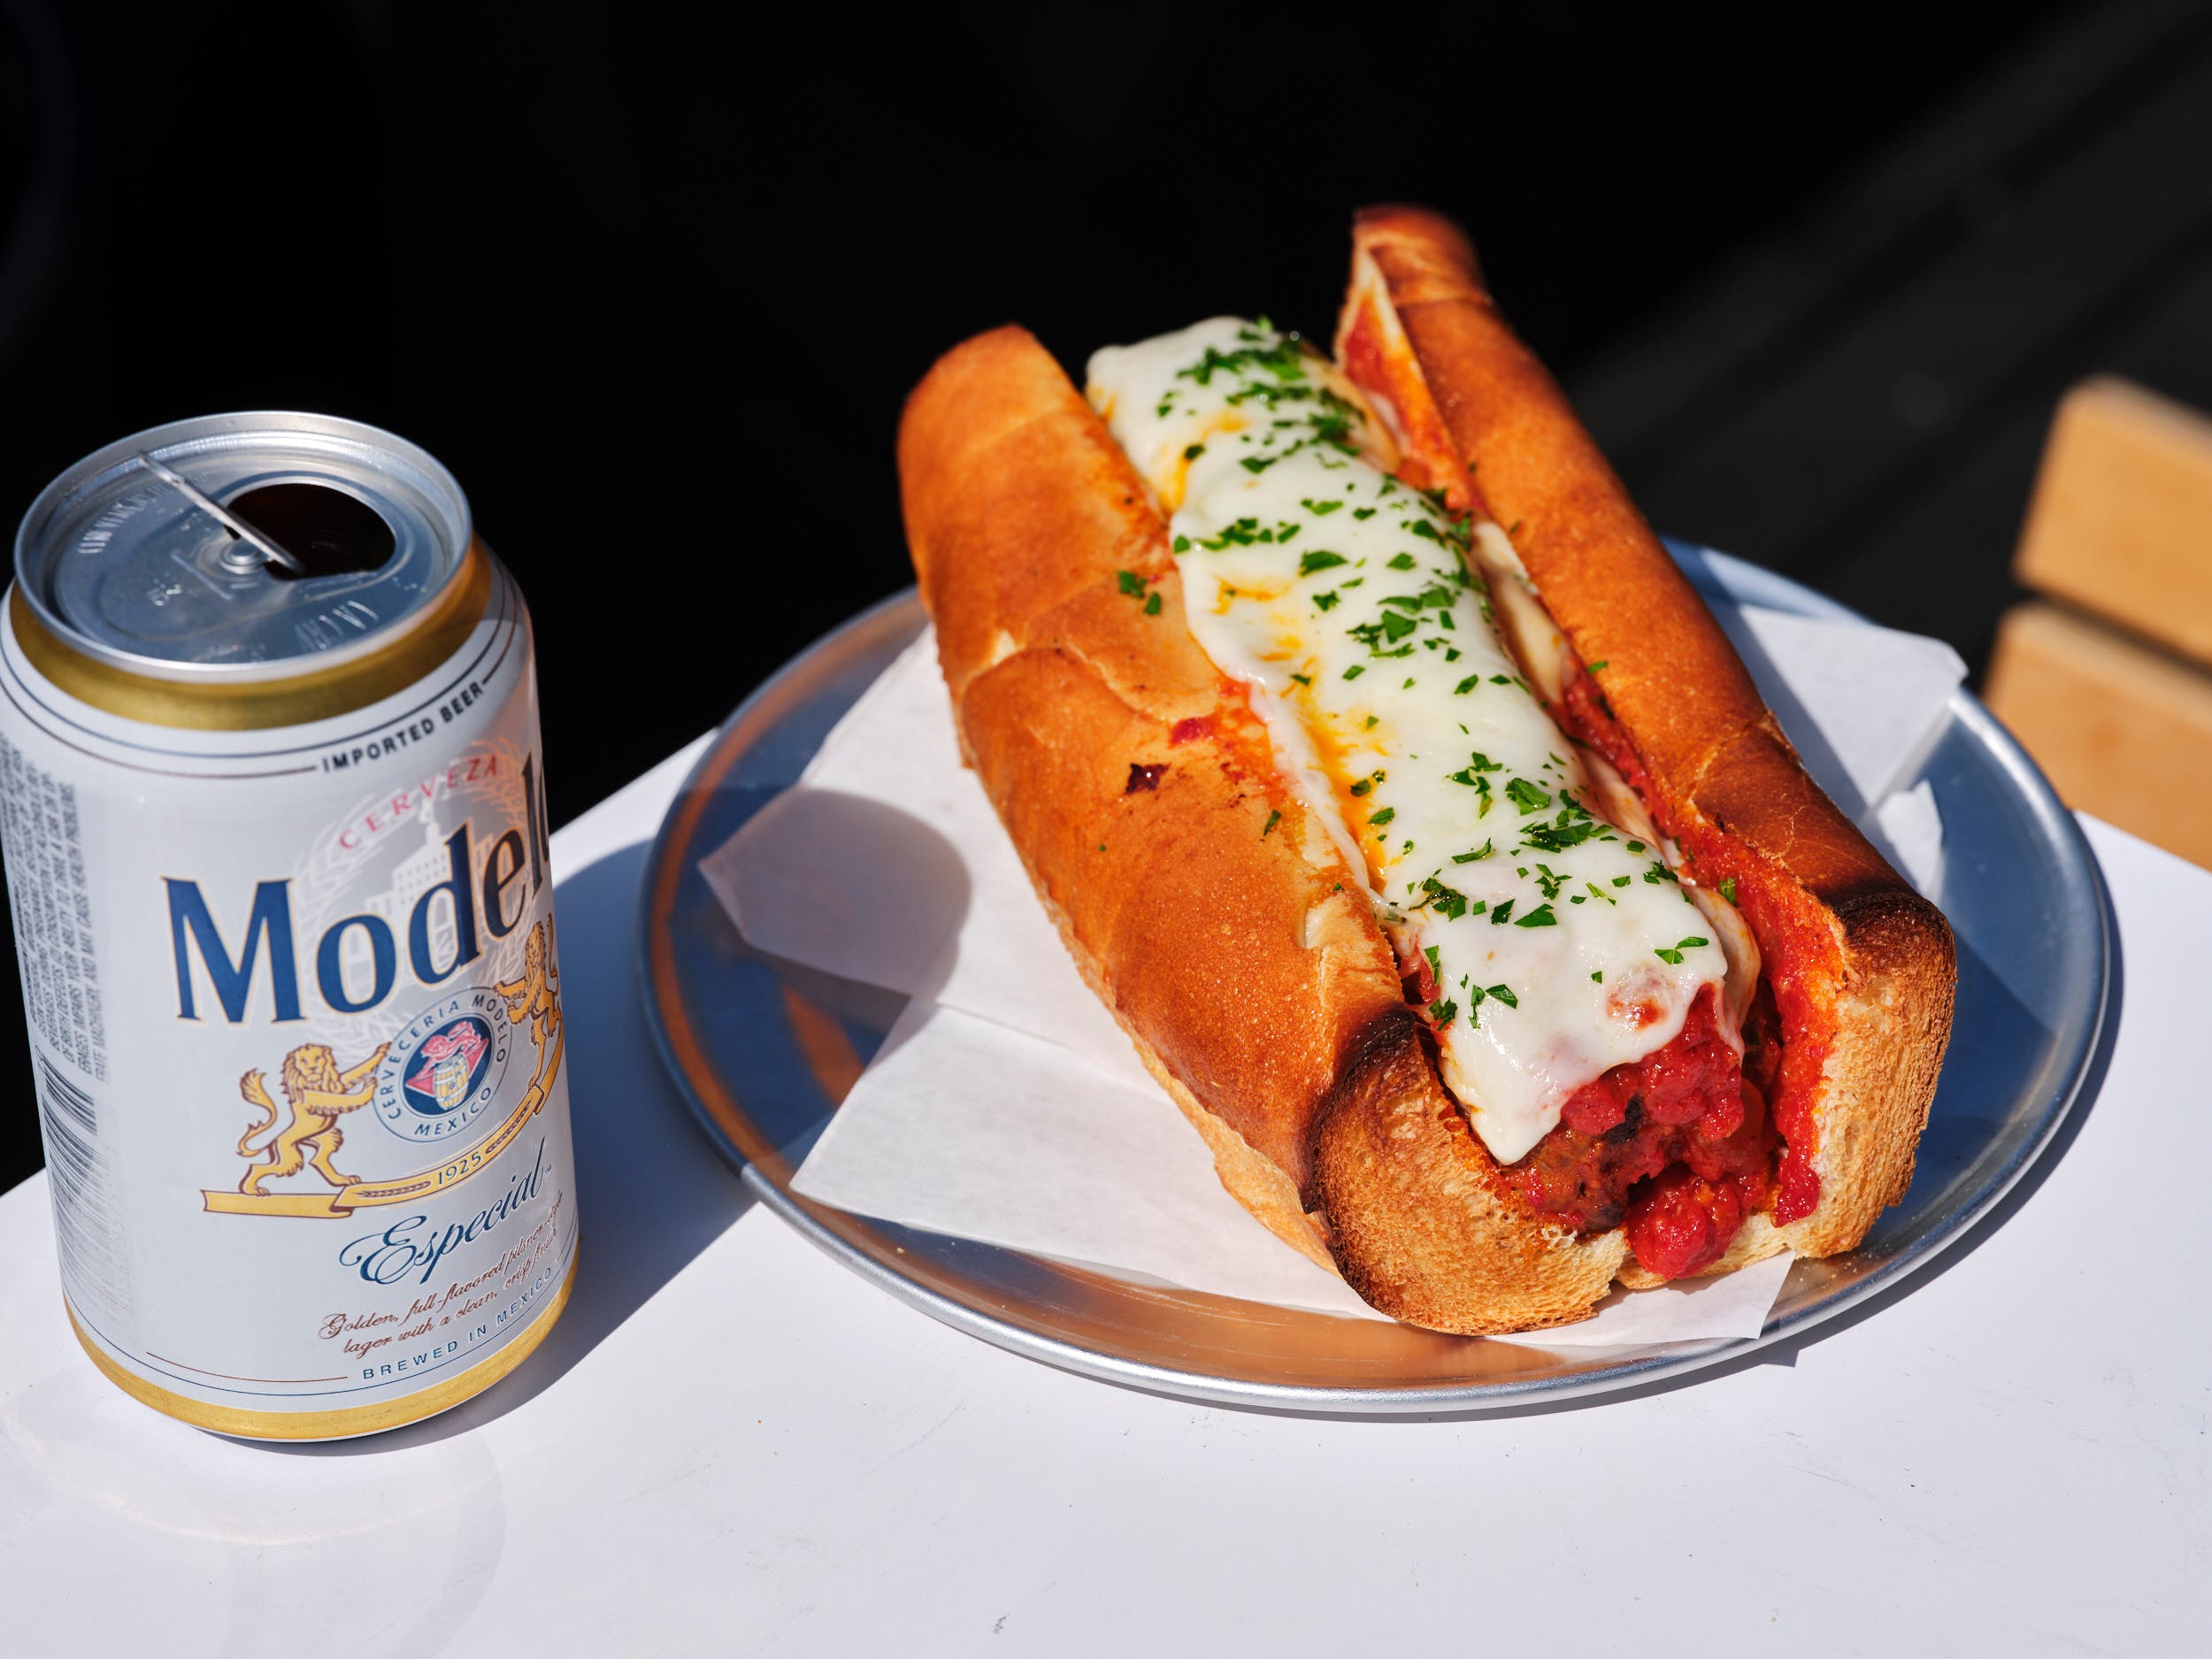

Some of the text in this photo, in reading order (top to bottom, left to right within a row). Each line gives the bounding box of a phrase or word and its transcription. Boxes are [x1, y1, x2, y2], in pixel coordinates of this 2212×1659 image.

[322, 680, 484, 773] IMPORTED BEER
[338, 754, 498, 849] CERVEZA
[380, 994, 507, 1119] CERVECERIA MODELO
[414, 1087, 492, 1136] MEXICO
[339, 1134, 546, 1285] Especial
[438, 1150, 482, 1185] 1925
[319, 1313, 399, 1340] Golden,
[397, 1252, 507, 1326] full-flavored
[343, 1337, 393, 1359] lager
[398, 1319, 434, 1341] with
[439, 1315, 450, 1327] a
[455, 1291, 498, 1317] clean,
[363, 1266, 552, 1380] BREWED IN MEXICO
